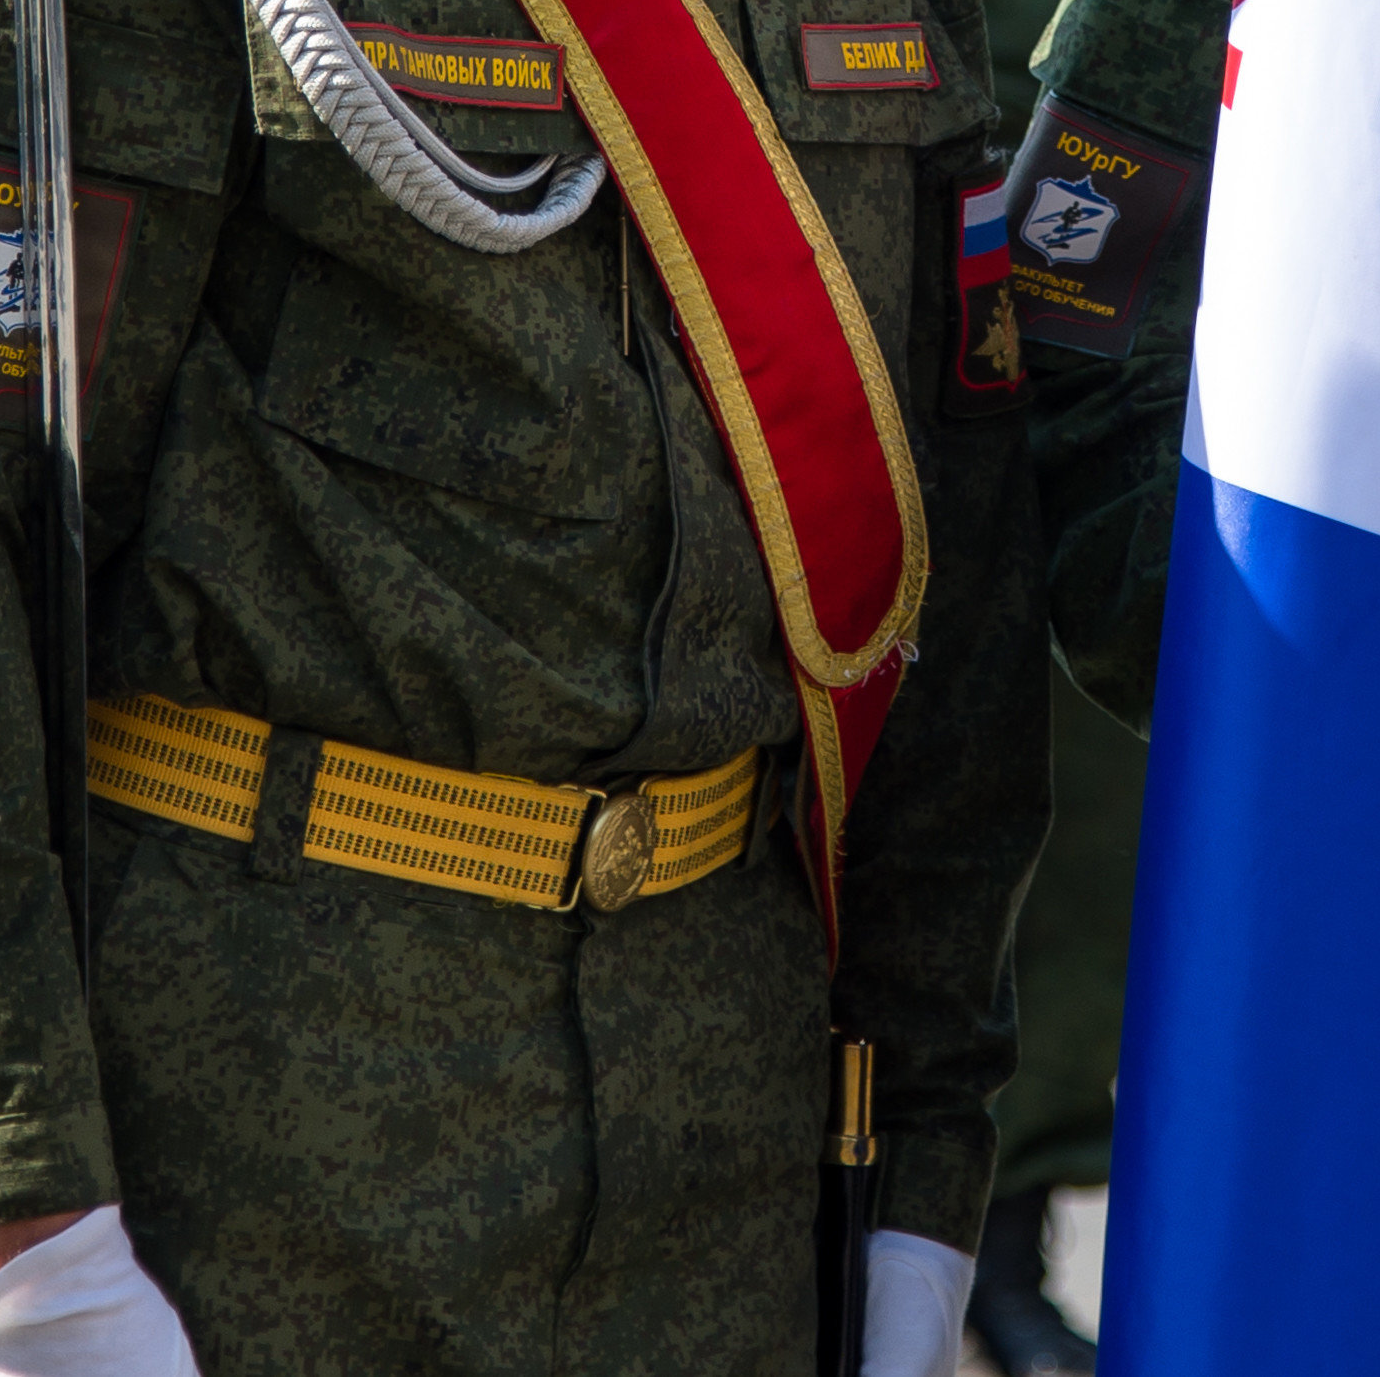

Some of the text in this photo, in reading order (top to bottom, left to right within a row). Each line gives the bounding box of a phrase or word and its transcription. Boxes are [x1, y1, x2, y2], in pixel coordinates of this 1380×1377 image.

[357, 41, 552, 90] ДРА ТАНКОВЫХ ВОЙСК
[841, 41, 901, 70] БЕЛИК
[1057, 131, 1141, 179] ЮУрГУ
[1043, 286, 1116, 318] ОБУЧЕНИЯ
